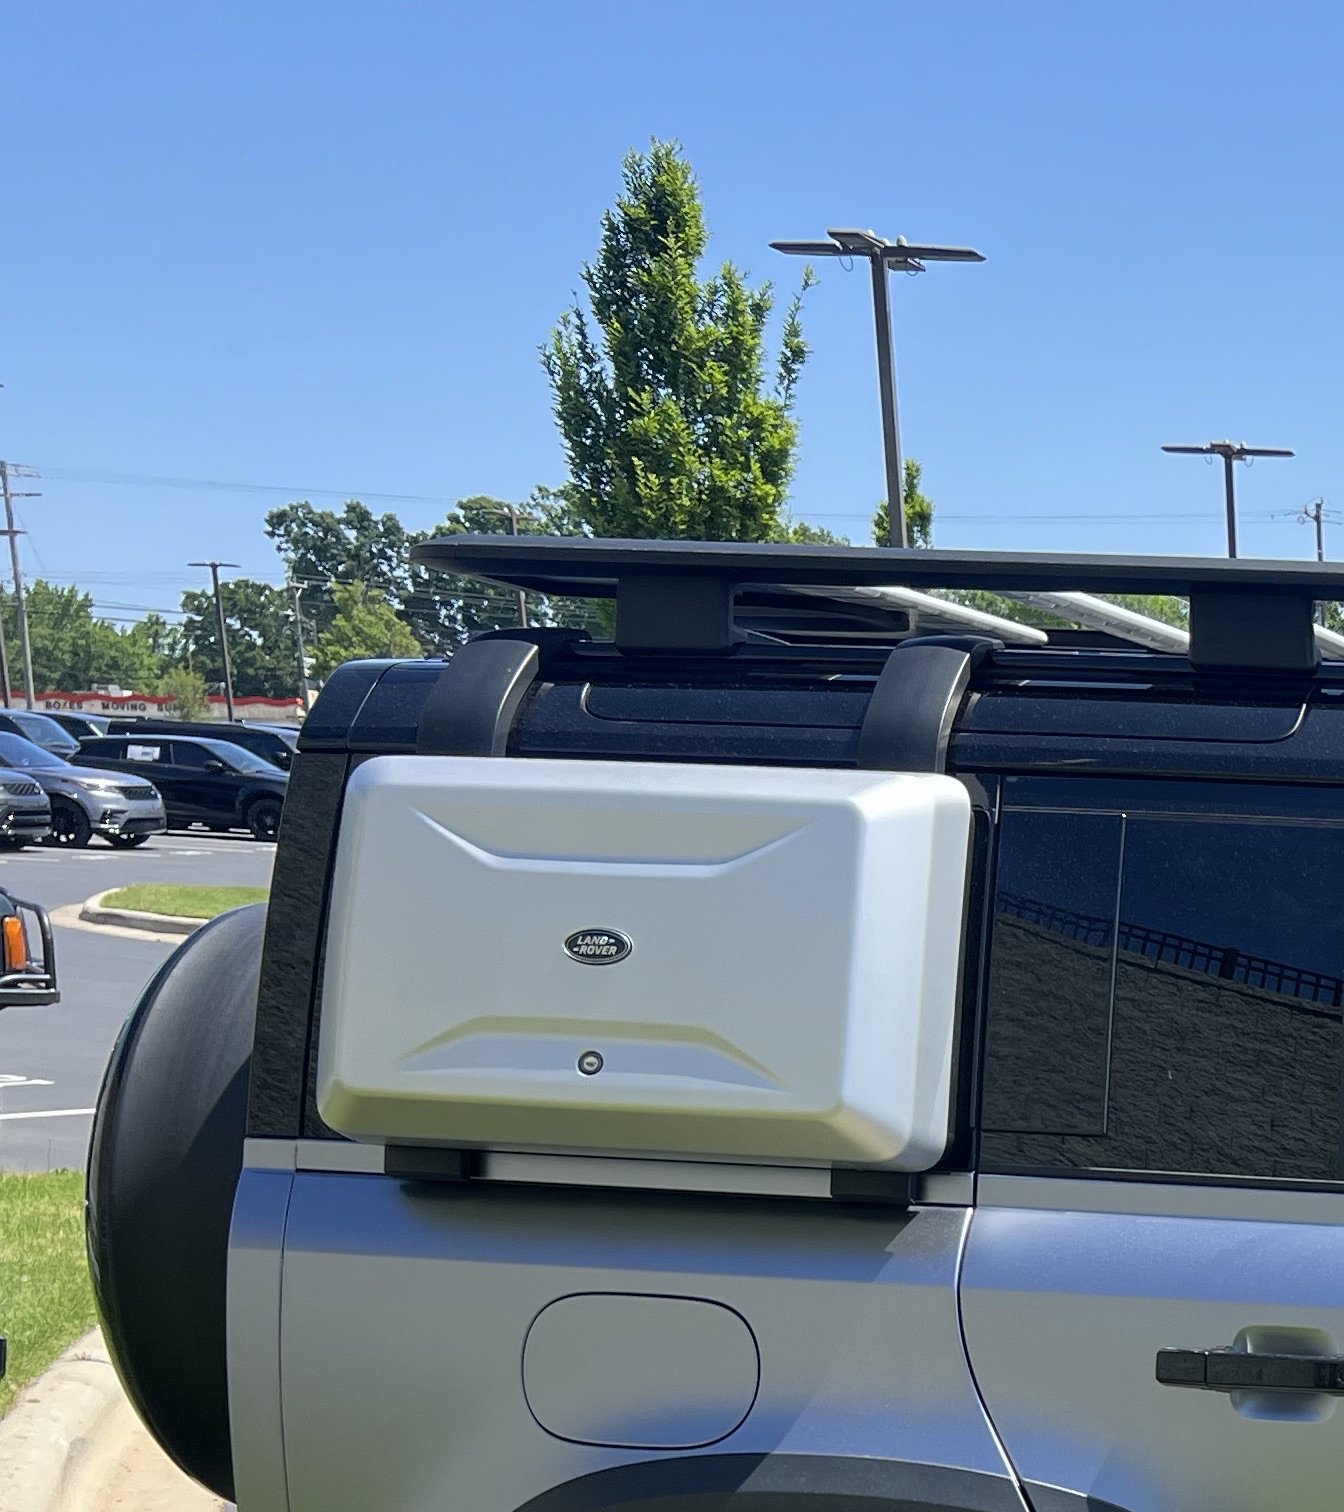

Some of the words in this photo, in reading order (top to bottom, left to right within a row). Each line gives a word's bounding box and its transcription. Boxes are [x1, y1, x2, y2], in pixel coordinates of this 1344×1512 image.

[101, 702, 147, 712] MOVING
[577, 936, 609, 945] LAND
[578, 945, 617, 955] ROVER
